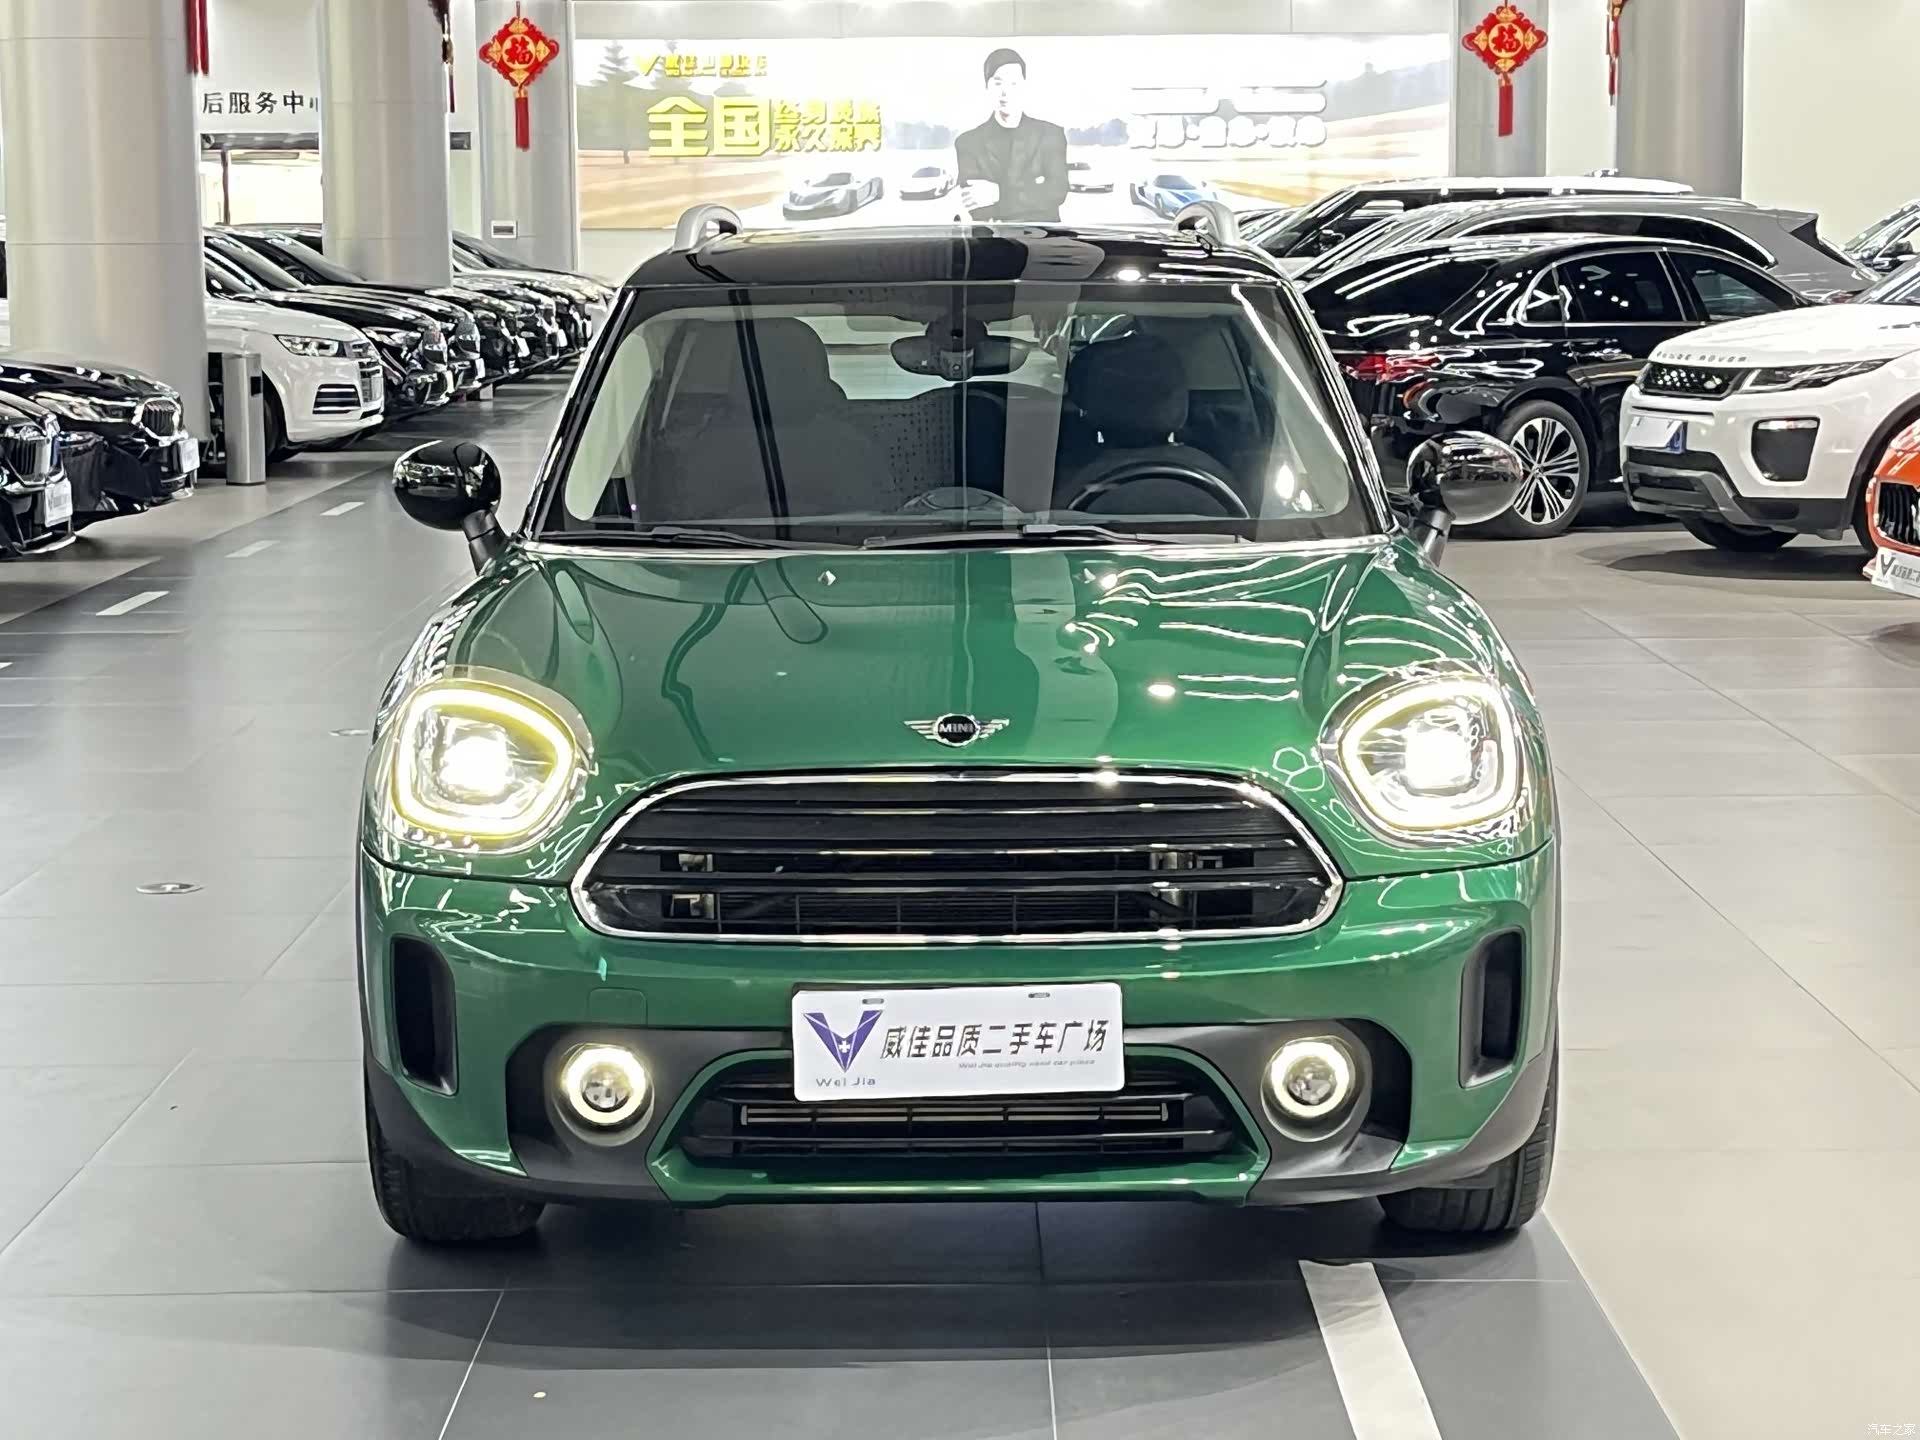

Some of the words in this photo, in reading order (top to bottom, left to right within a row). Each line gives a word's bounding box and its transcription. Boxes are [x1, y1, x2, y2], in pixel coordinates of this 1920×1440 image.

[647, 96, 771, 157] 全国
[939, 723, 974, 733] MINI
[880, 1019, 1109, 1059] 威佳品质二手车广场
